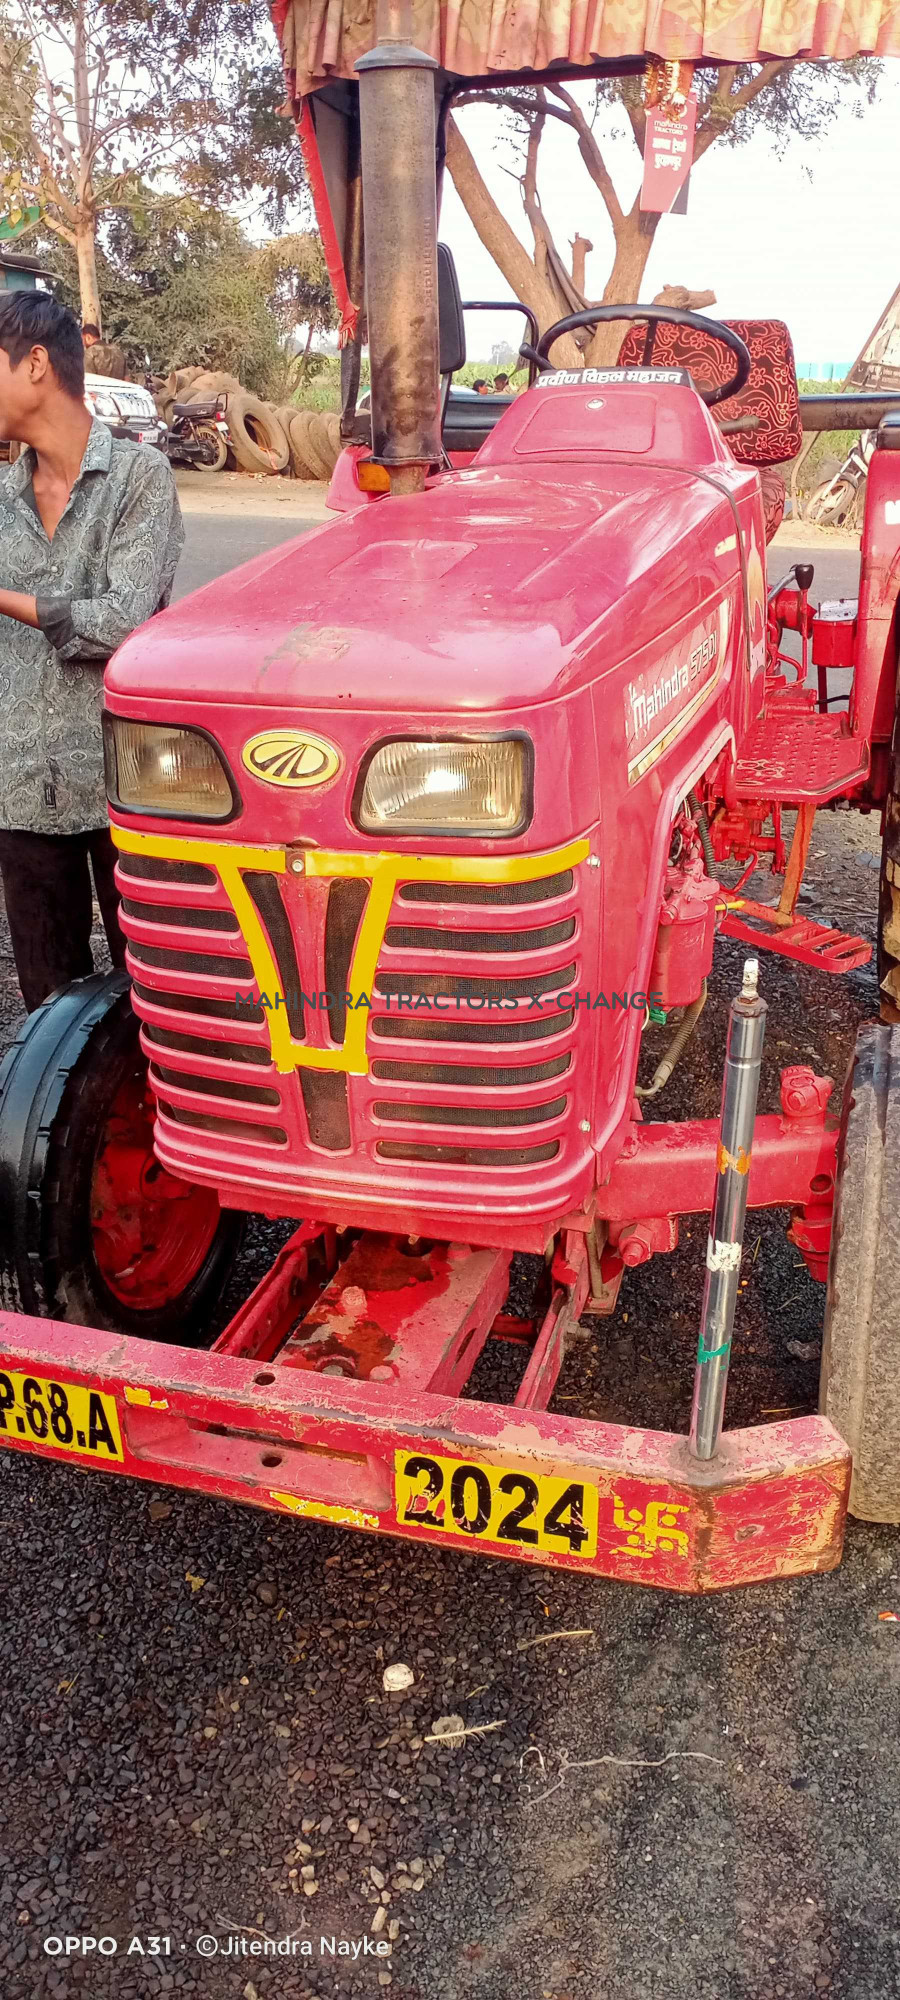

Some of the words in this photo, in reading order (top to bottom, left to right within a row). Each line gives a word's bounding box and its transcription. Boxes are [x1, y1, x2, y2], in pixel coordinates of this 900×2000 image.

[536, 370, 580, 388] प्रवीण
[627, 371, 683, 384] महाजन
[404, 1456, 589, 1552] 2024
